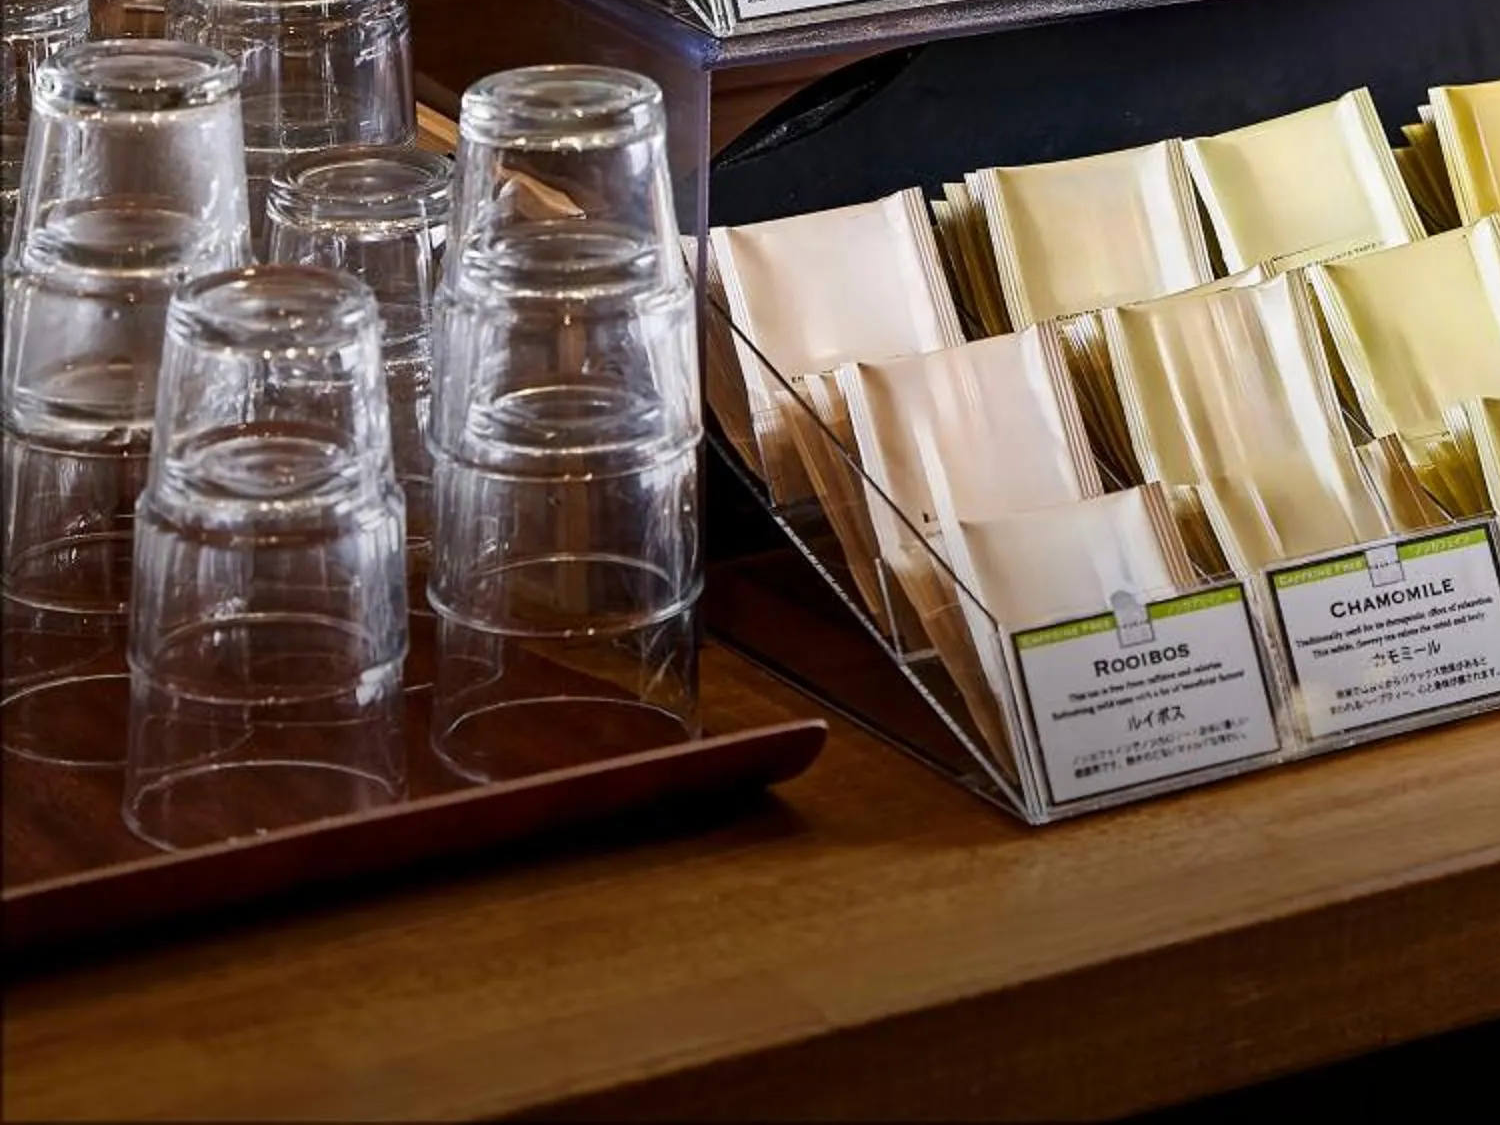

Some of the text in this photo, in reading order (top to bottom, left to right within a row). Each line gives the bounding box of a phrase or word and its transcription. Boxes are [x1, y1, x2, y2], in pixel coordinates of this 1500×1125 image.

[1329, 578, 1455, 619] CHAMOMILE
[1093, 643, 1191, 678] ROOIBOS
[1128, 705, 1185, 731] ルイボス
